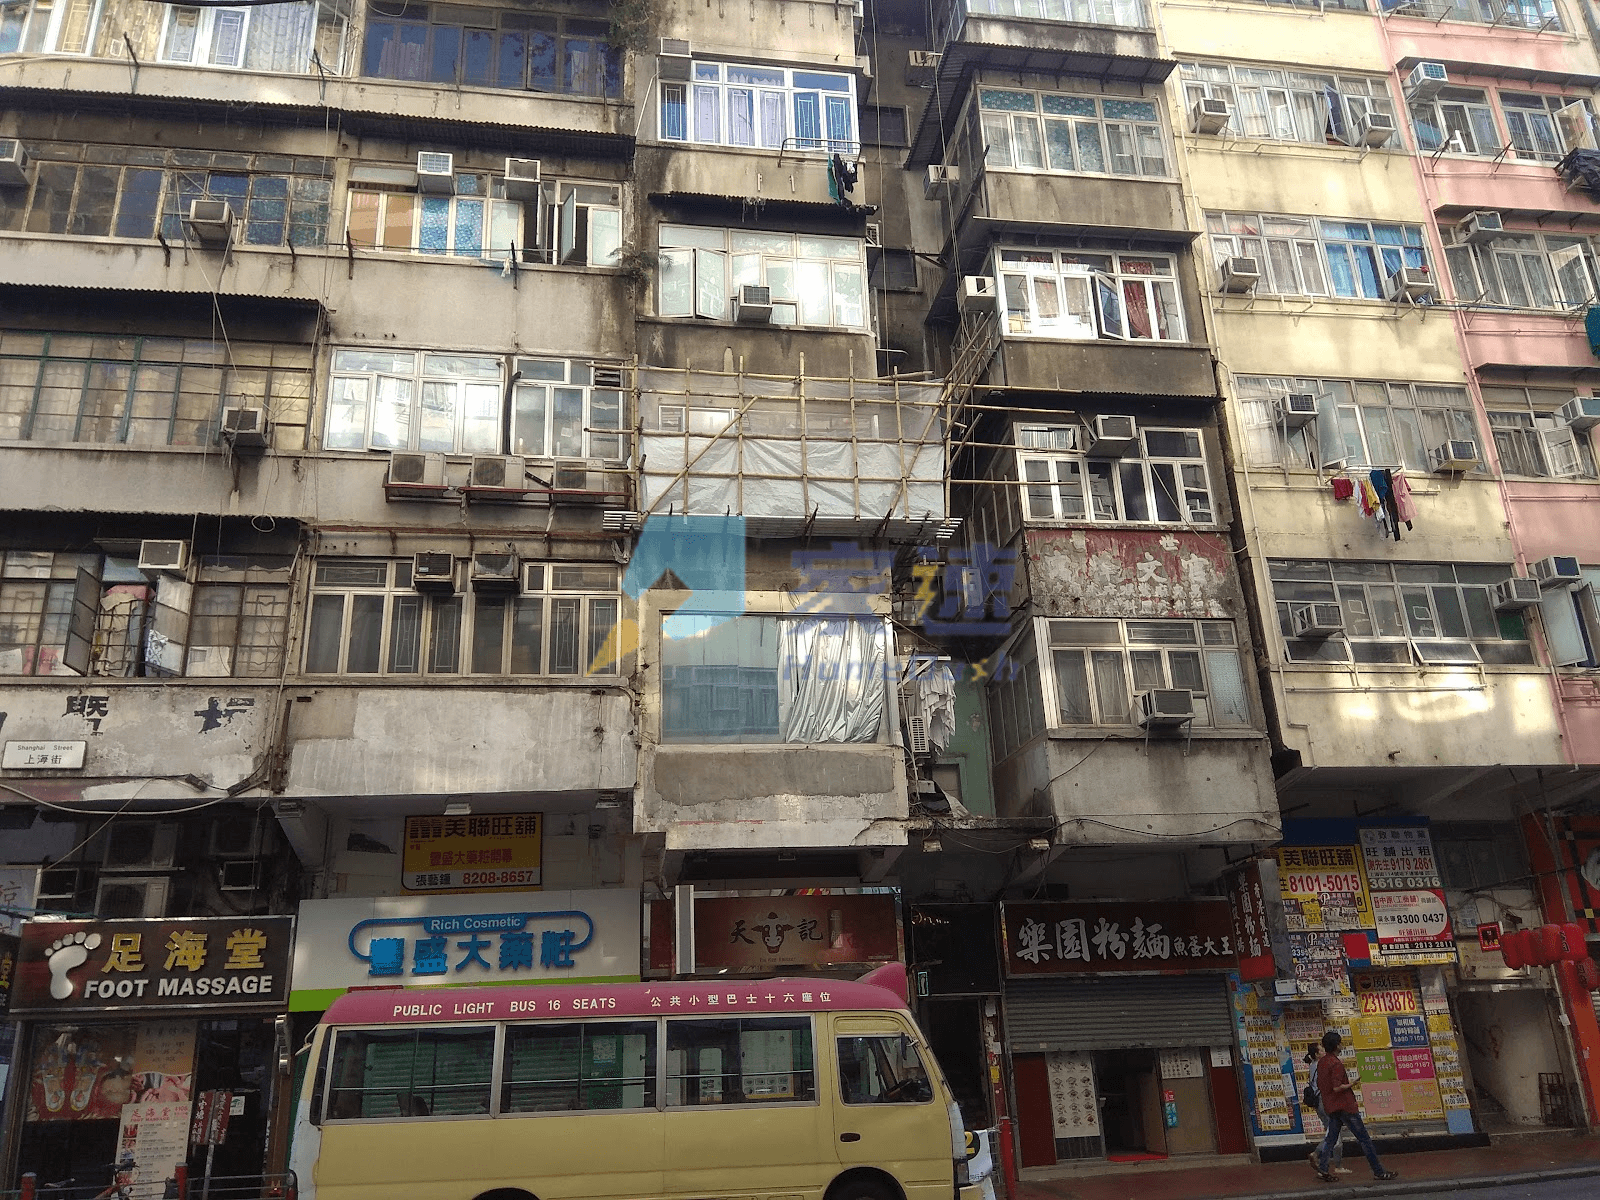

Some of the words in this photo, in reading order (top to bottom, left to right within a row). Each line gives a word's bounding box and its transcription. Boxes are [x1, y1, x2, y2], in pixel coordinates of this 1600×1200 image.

[23, 754, 63, 765] 上海街
[444, 816, 537, 838] 美聯旺舖
[1282, 848, 1354, 867] 美聯旺舖
[462, 870, 533, 885] 8208-8657
[1288, 874, 1360, 892] 8101-5015
[1369, 877, 1404, 889] 3616
[1406, 876, 1441, 888] 0316
[431, 919, 459, 930] Rich
[463, 916, 521, 929] Cosmetic
[1397, 915, 1420, 924] 8300
[1422, 913, 1445, 923] 0437
[101, 928, 267, 973] 足海堂
[1173, 936, 1234, 957] 魚蛋大王
[84, 980, 149, 999] FOOT
[157, 975, 273, 997] MASSAGE
[1373, 974, 1402, 988] 威信
[393, 1004, 443, 1016] PUBLIC
[453, 1002, 494, 1015] LIGHT
[510, 1000, 536, 1012] BUS
[548, 1000, 561, 1011] 16
[573, 997, 616, 1009] SEATS
[1361, 991, 1416, 1013] 23113878
